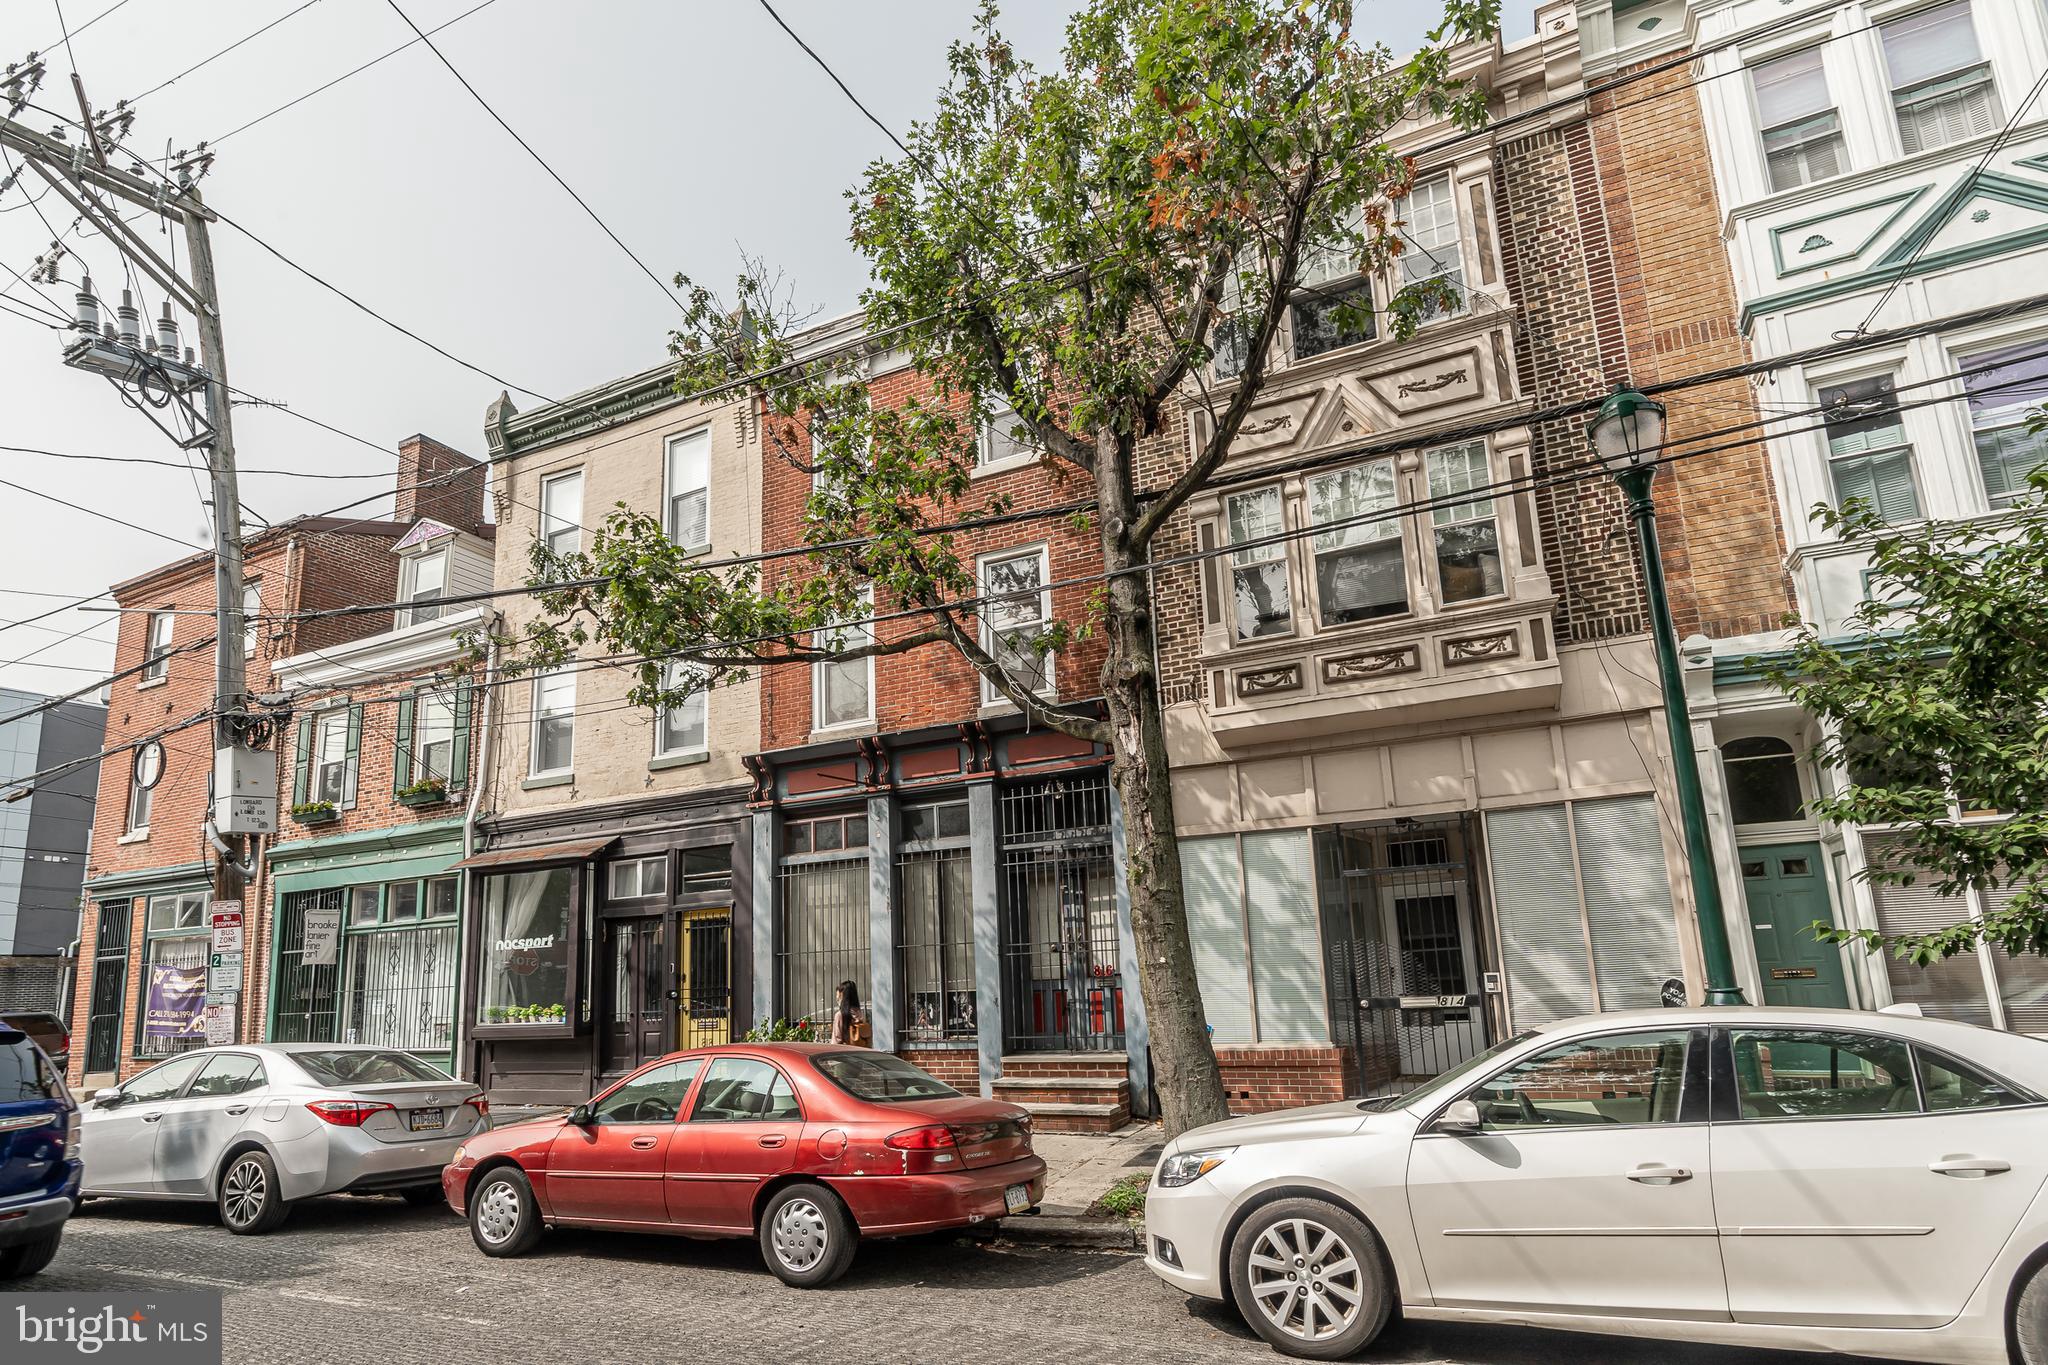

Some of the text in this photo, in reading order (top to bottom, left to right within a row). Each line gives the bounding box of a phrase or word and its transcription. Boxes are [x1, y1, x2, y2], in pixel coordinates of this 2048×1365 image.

[214, 920, 241, 928] STOPPING
[307, 919, 338, 929] brooke
[305, 939, 320, 950] fine
[495, 933, 554, 951] nacsport
[212, 955, 220, 966] 2
[1440, 996, 1465, 1006] 814
[207, 1007, 219, 1018] NO
